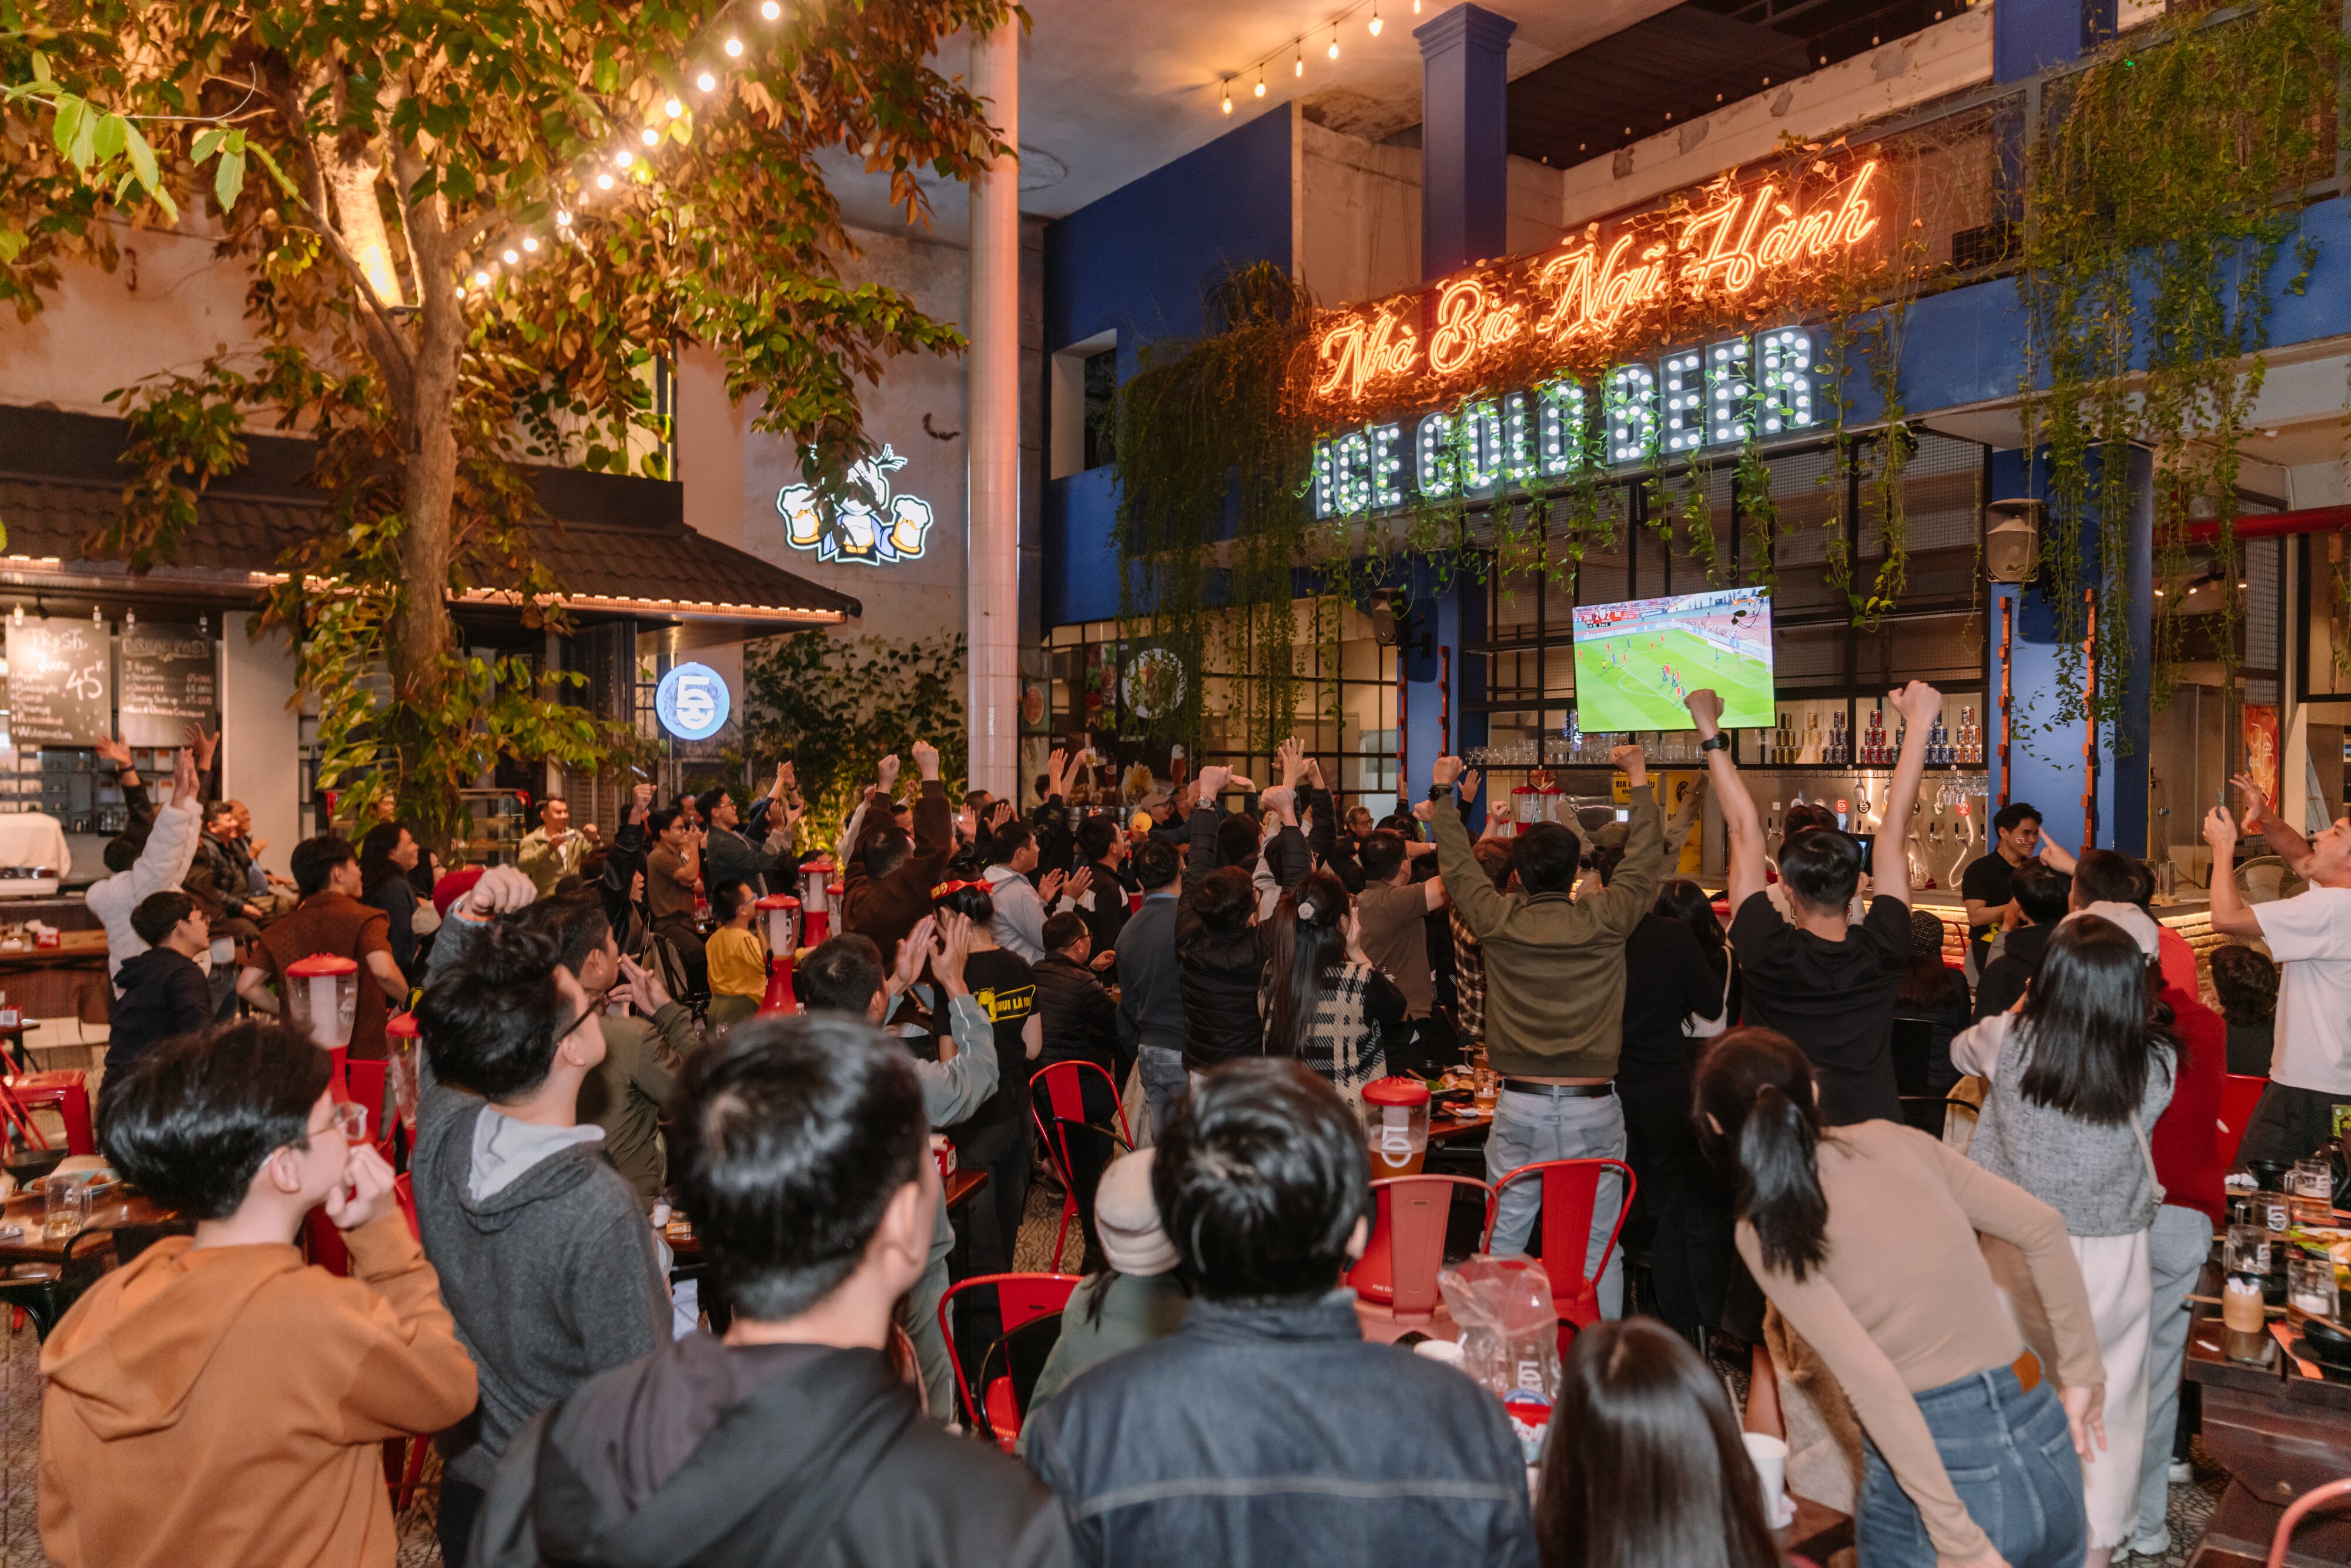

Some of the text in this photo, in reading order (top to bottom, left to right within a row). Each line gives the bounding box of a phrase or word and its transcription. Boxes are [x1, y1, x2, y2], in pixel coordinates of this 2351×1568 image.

[1318, 161, 1880, 398] Nhà Bia Ngũ Hành
[1315, 325, 1812, 520] ICE COLD BEER
[1595, 612, 1599, 621] 2
[1606, 611, 1611, 619] 2
[1596, 630, 1614, 639] FOOTBALL
[1615, 626, 1637, 636] FEDERATION
[1013, 996, 1023, 1010] LÀ
